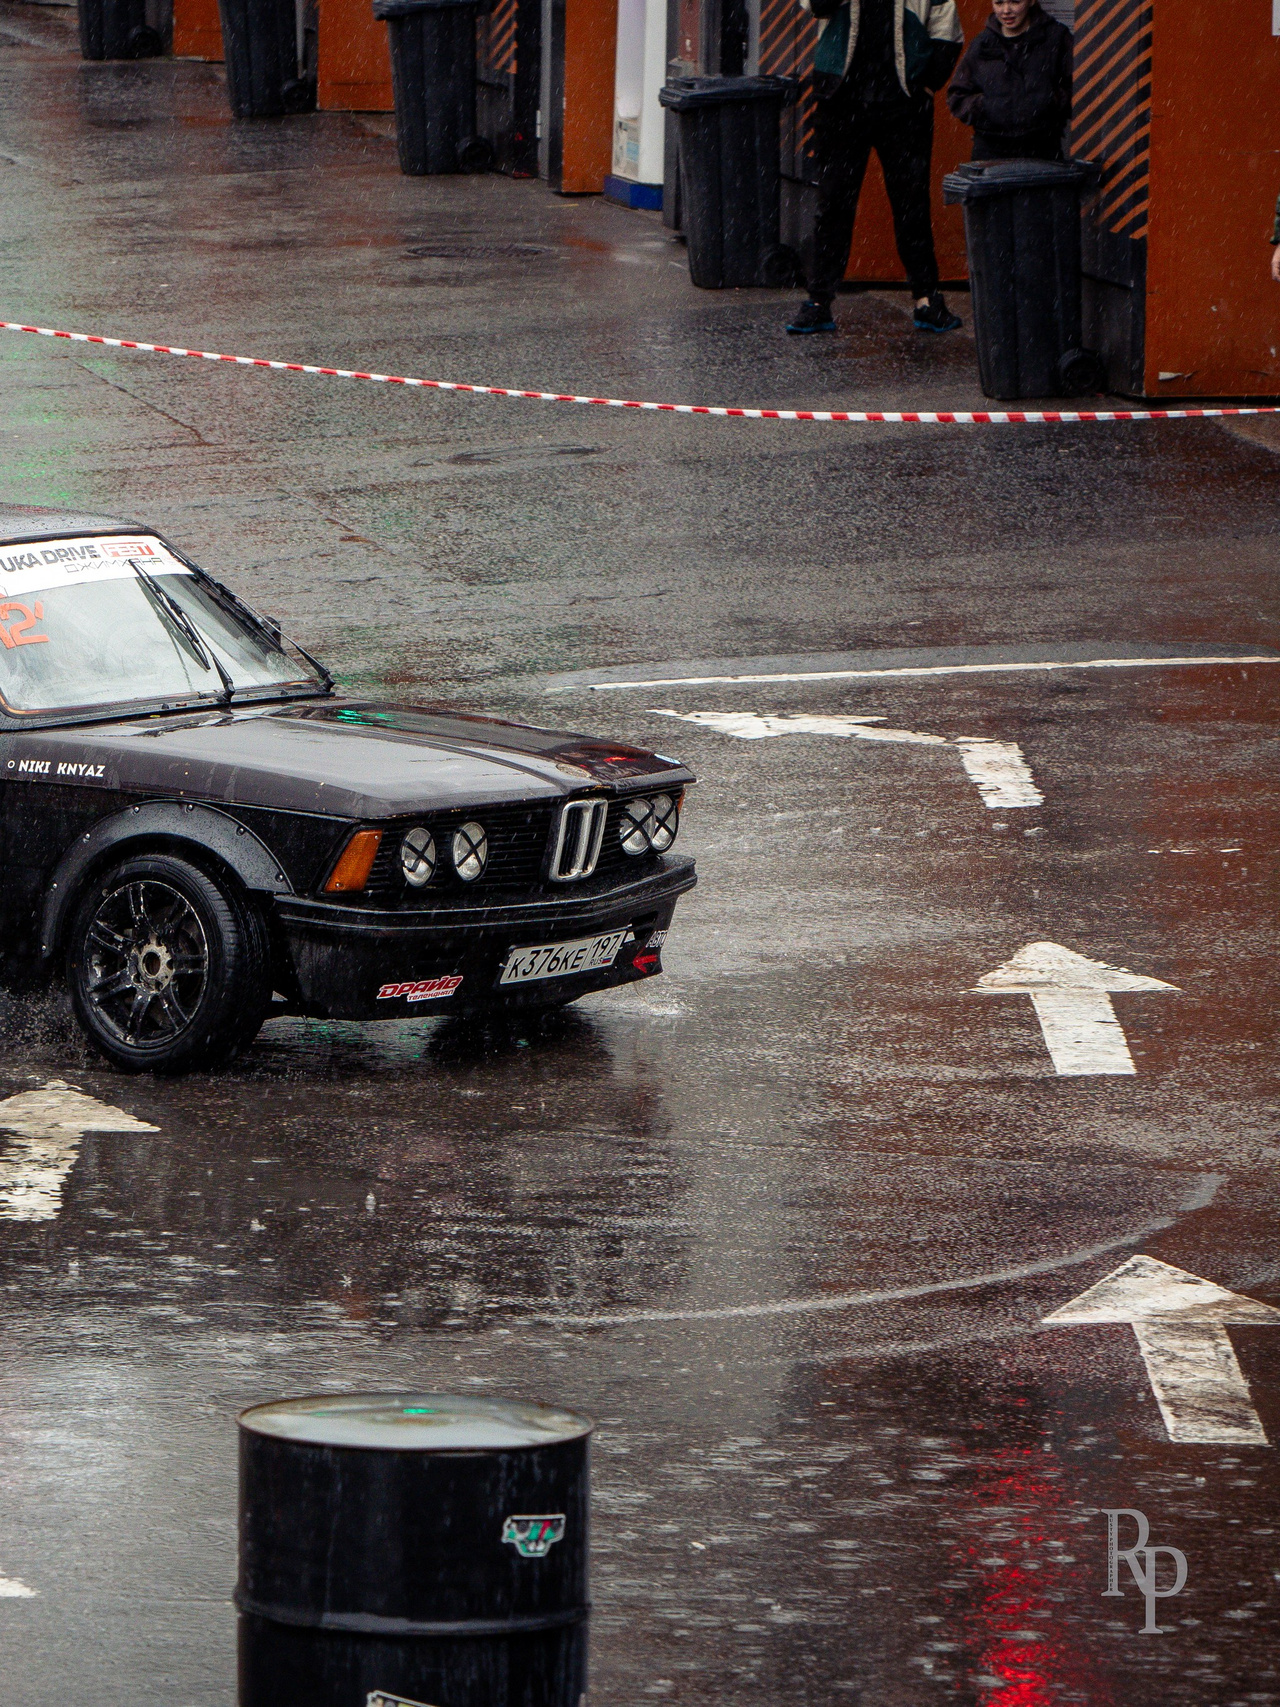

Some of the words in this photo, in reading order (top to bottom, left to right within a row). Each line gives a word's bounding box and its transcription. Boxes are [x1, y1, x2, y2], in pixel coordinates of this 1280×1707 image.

[40, 544, 102, 564] DRIVE
[18, 759, 52, 774] NIKI
[57, 762, 106, 777] KNYAZ
[507, 946, 588, 979] К376КЕ
[592, 934, 622, 958] 197
[589, 957, 603, 966] RUS
